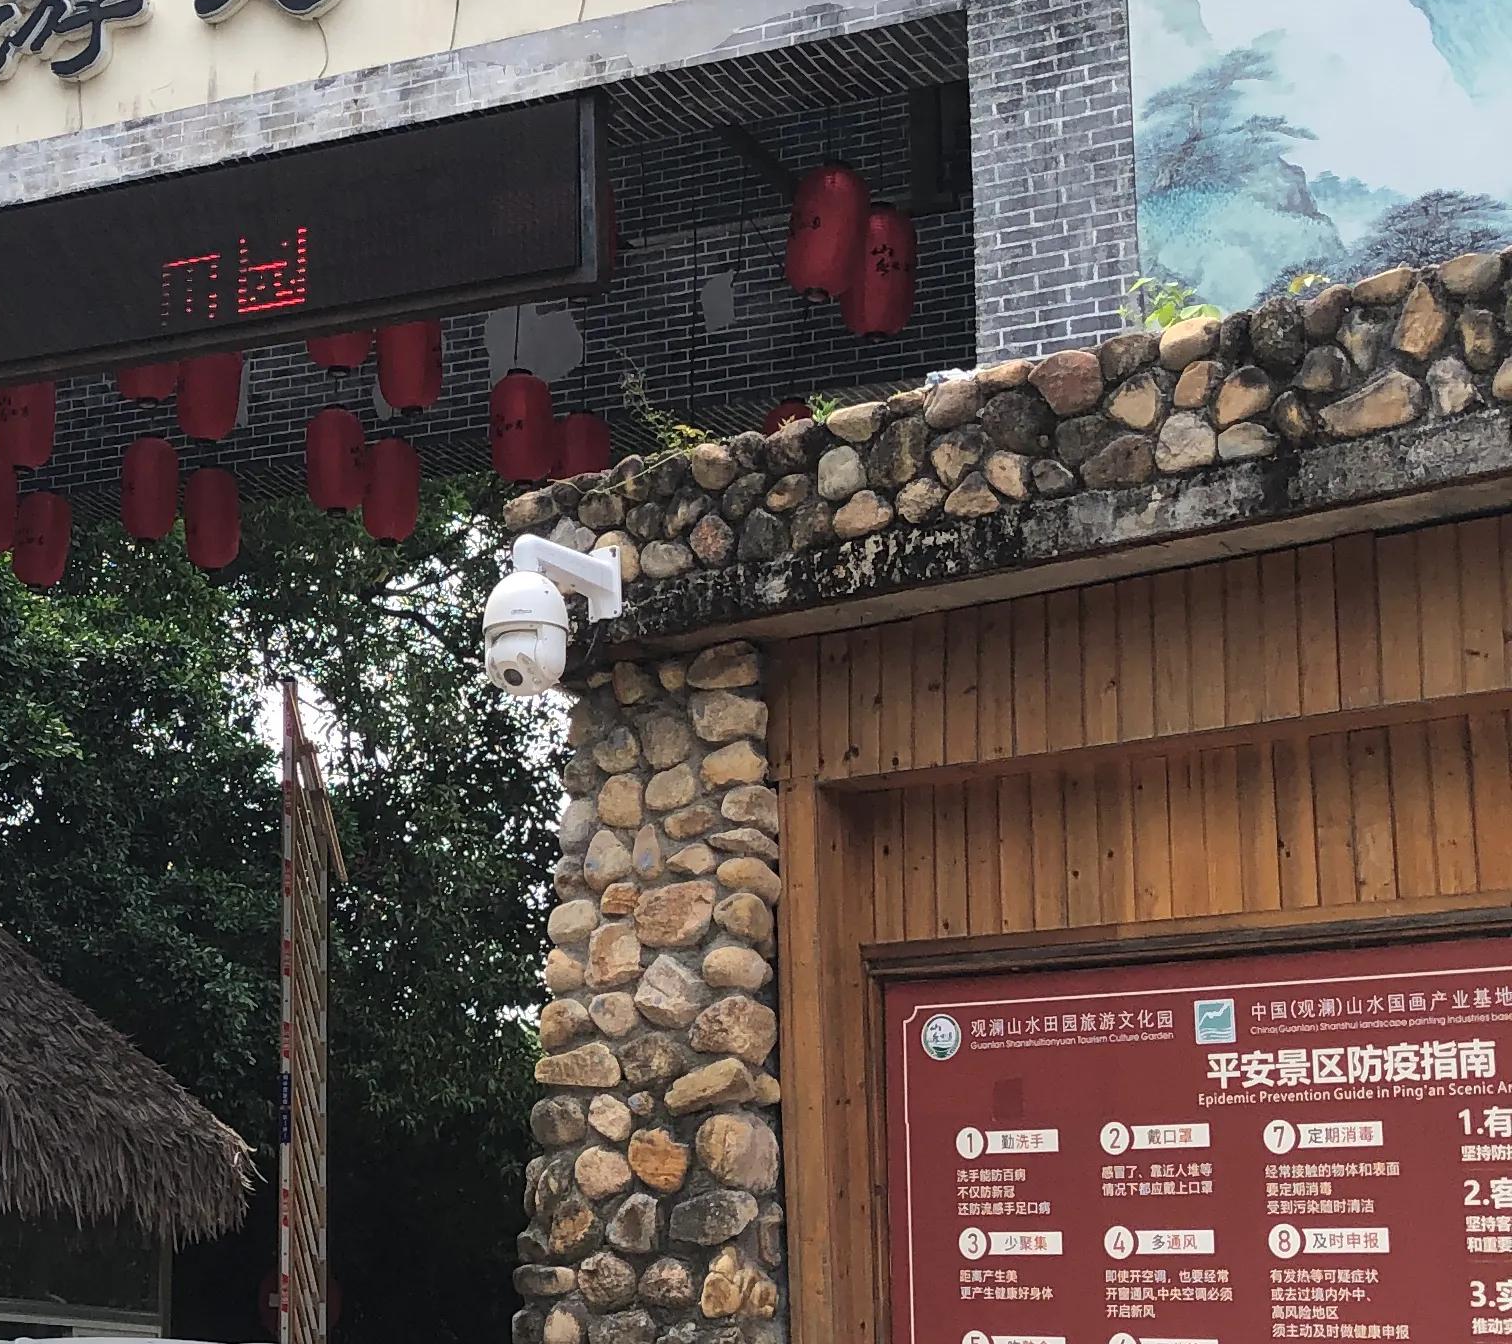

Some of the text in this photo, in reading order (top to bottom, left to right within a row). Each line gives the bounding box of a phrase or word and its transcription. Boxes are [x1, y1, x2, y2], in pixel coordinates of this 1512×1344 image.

[970, 1010, 1173, 1037] 观澜山水田园旅游文化园
[1207, 1038, 1496, 1089] 平安景区防疫指南
[1198, 1092, 1256, 1108] Epidemic
[1259, 1089, 1330, 1103] Prevention
[1334, 1087, 1374, 1100] Guide
[1377, 1087, 1390, 1099] in
[1448, 1083, 1493, 1095] Scenic
[1001, 1133, 1044, 1150] 勤洗手
[1147, 1128, 1193, 1145] 戴口罩
[1308, 1126, 1374, 1145] 定期消毒
[956, 1168, 1026, 1183] 洗手能防百病
[1265, 1161, 1400, 1179] 经常接触的物体和表面
[957, 1185, 1015, 1199] 不仅防新冠
[1266, 1182, 1332, 1197] 要定期消毒
[957, 1201, 1051, 1216] 还防流感手足口病
[1266, 1199, 1375, 1215] 受到污染随时清洁
[1004, 1235, 1048, 1252] 少聚集
[1152, 1234, 1197, 1250] 多通风
[1312, 1232, 1379, 1250] 及时申报
[959, 1269, 1018, 1283] 距离产生美
[1270, 1269, 1379, 1284] 有发热等可疑症状
[960, 1286, 1054, 1300] 更产生健康好身体
[1106, 1304, 1155, 1318] 开启新风
[1272, 1305, 1339, 1320] 高风险地区
